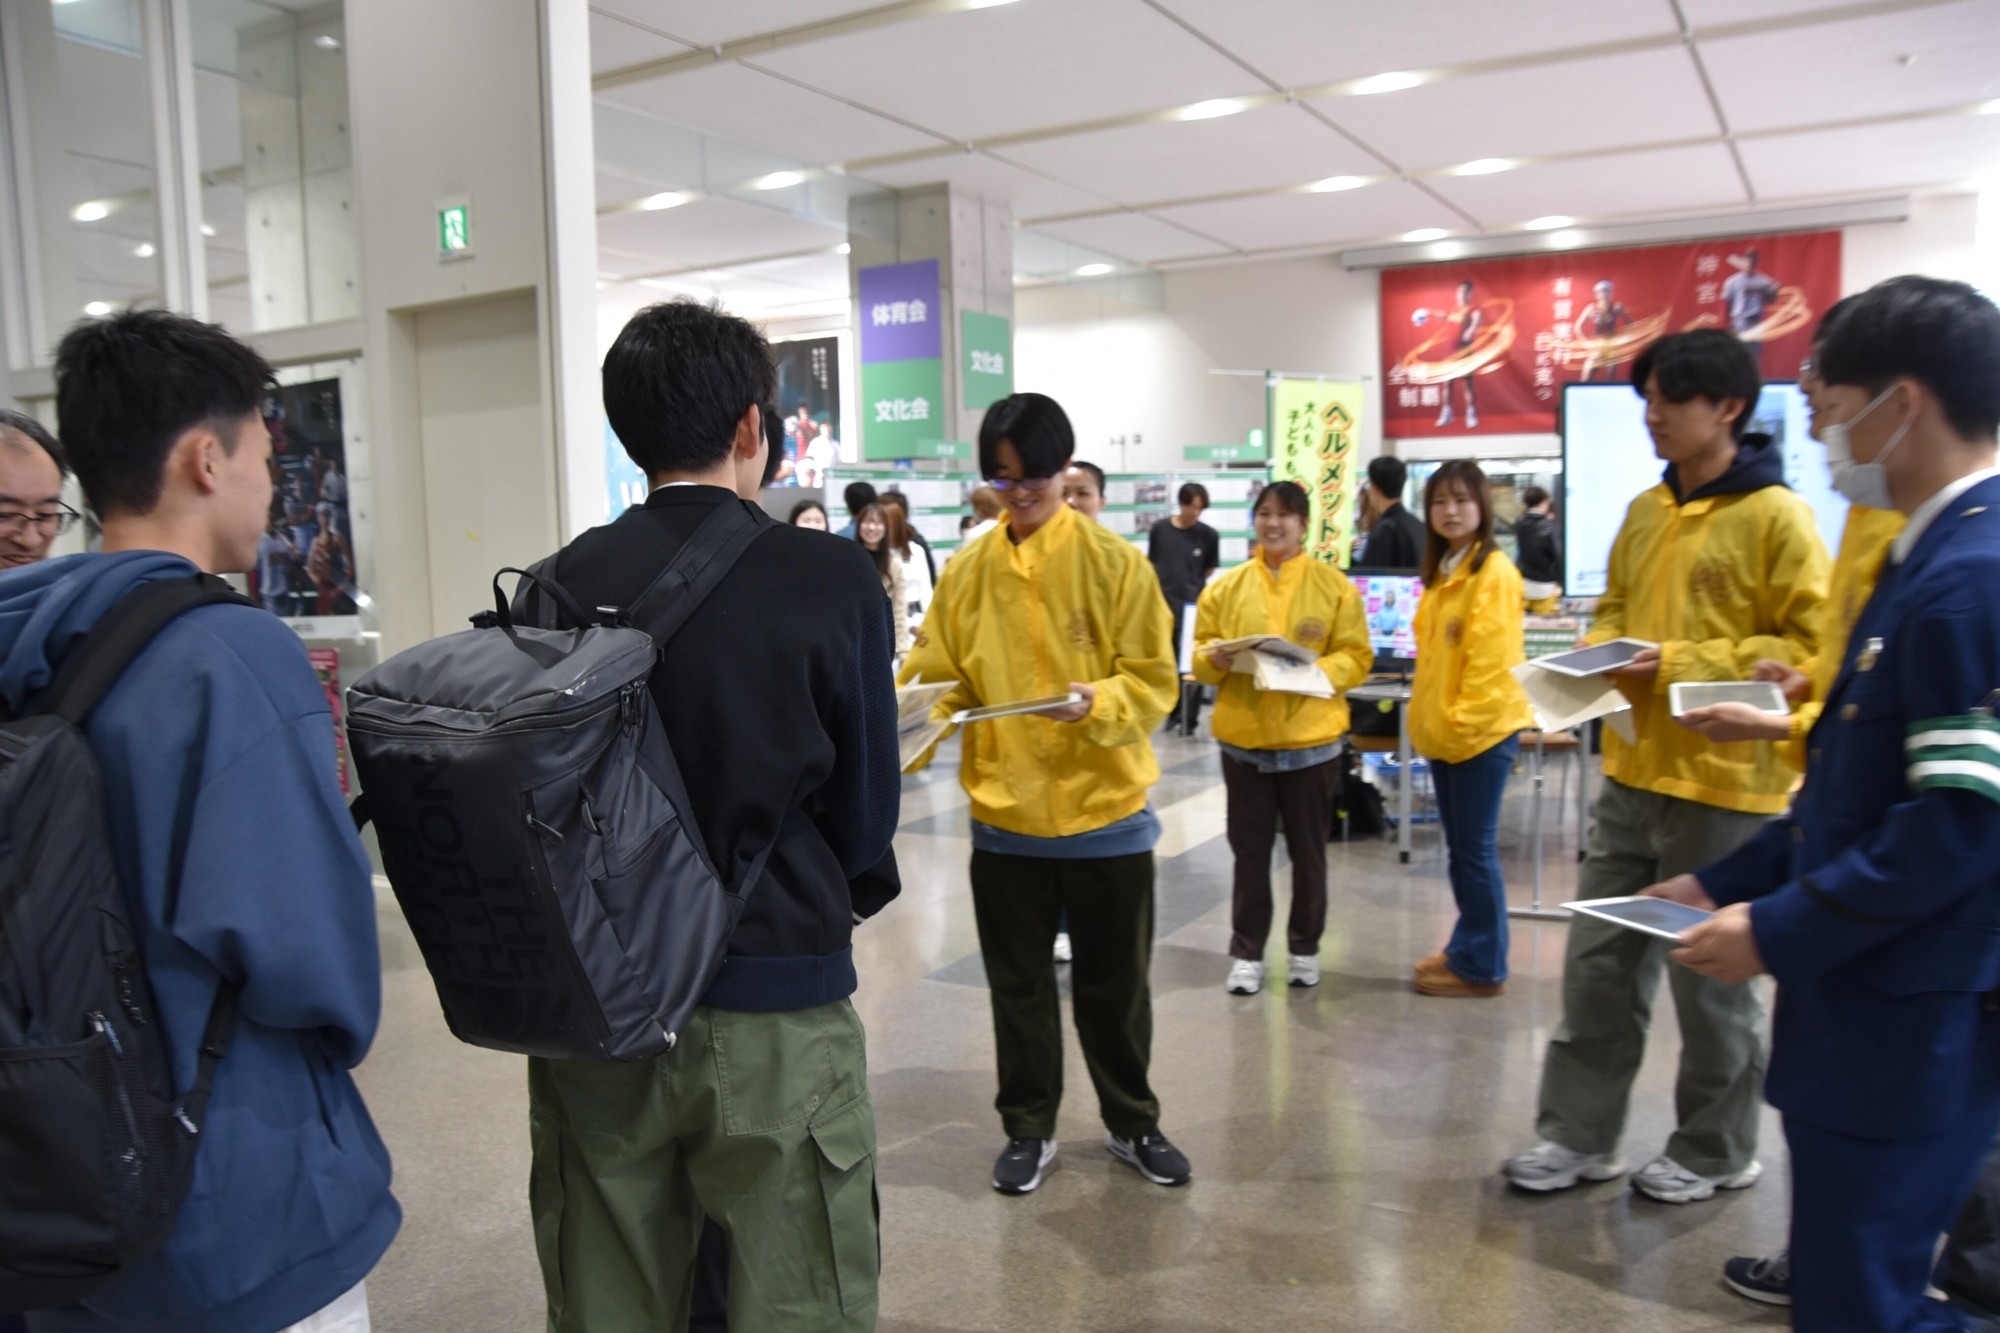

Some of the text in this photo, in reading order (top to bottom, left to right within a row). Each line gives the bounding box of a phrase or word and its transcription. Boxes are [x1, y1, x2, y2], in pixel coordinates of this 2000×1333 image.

[871, 299, 927, 327] 体育会
[970, 350, 1005, 375] 文化会
[874, 396, 930, 423] 文化会
[1304, 401, 1315, 447] 大人も
[410, 755, 514, 983] NORTH
[481, 862, 553, 982] THE
